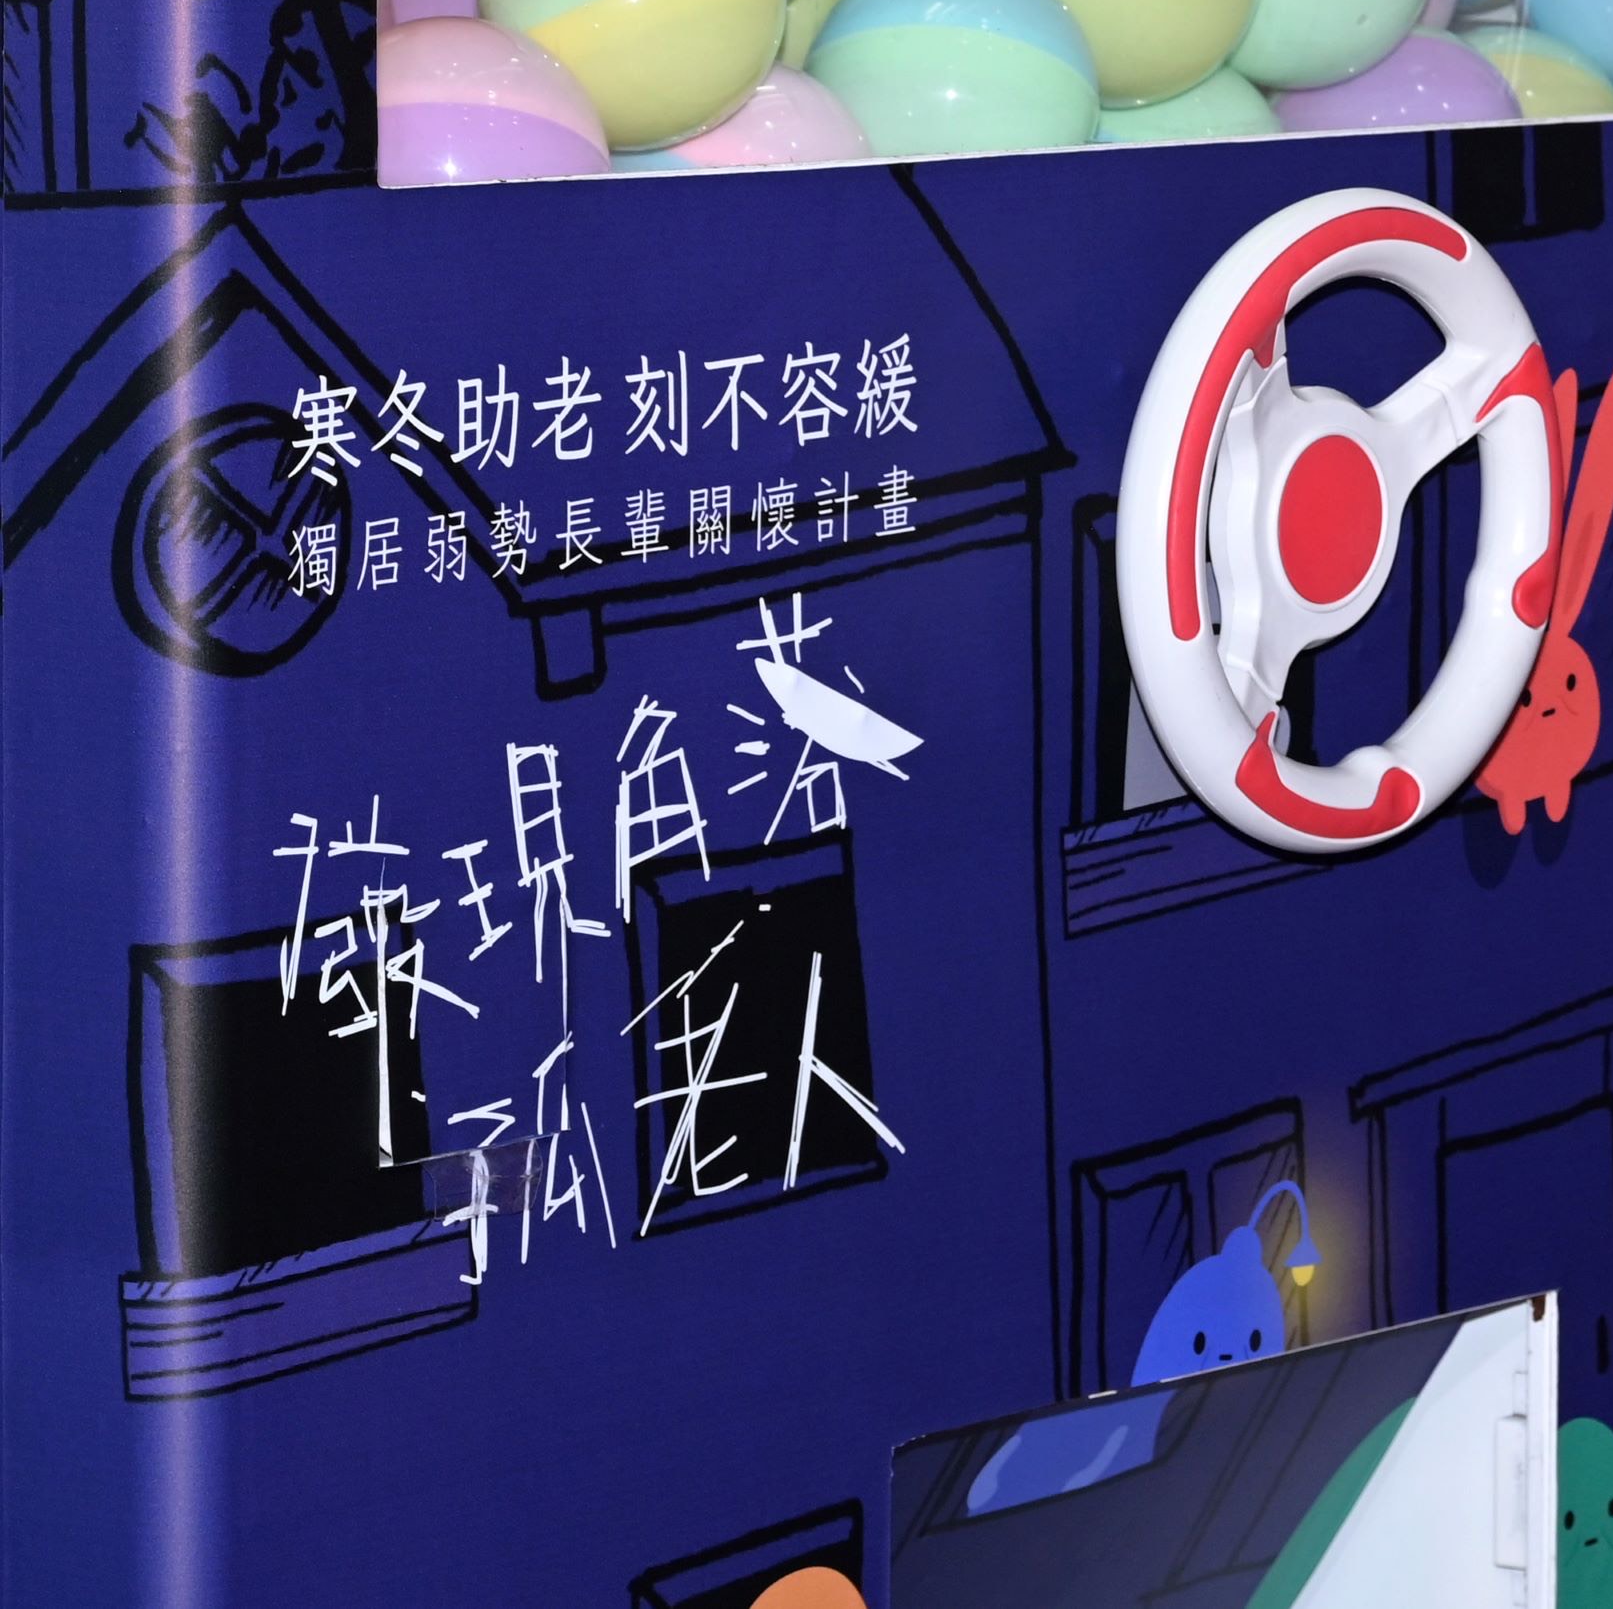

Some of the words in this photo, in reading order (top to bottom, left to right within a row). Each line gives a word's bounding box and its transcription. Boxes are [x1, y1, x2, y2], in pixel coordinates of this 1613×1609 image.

[287, 356, 601, 487] 寒冬助老
[624, 332, 919, 457] 刻不容緩
[286, 463, 918, 598] 獨居弱勢長輩關懷計畫
